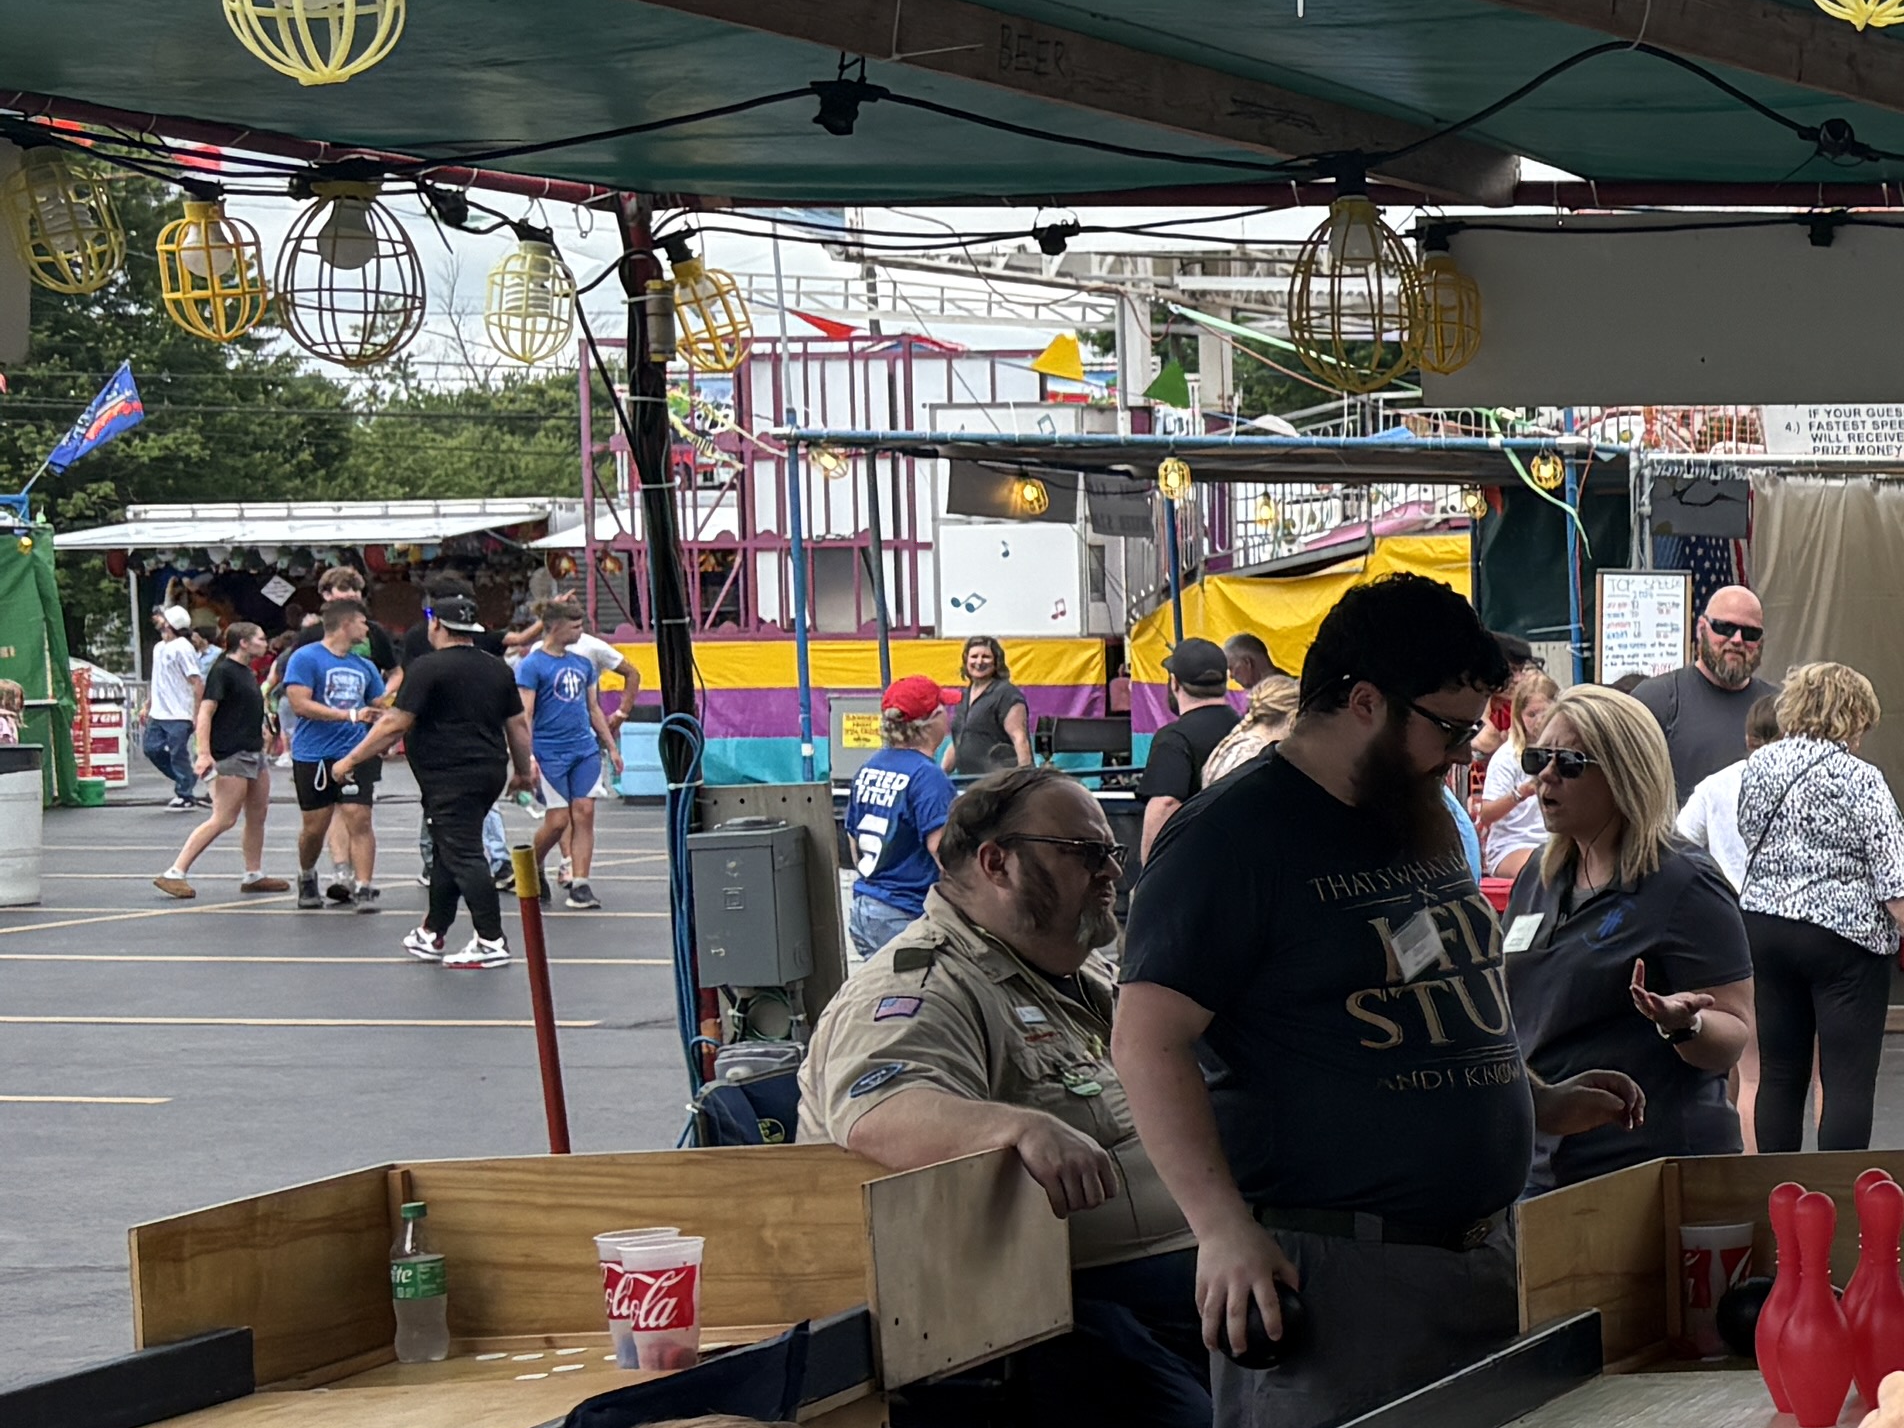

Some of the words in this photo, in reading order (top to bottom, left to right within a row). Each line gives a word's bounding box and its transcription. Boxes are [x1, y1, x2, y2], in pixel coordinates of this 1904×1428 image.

[1808, 408, 1820, 419] IF
[1824, 407, 1862, 419] YOUR
[1808, 421, 1868, 433] FASTEST
[1811, 432, 1844, 444] WILL
[1848, 432, 1904, 444] RECEIVE
[1812, 445, 1851, 456] PRIZE
[1855, 444, 1903, 456] MONEY
[1345, 967, 1510, 1050] STU
[391, 1263, 413, 1285] ite
